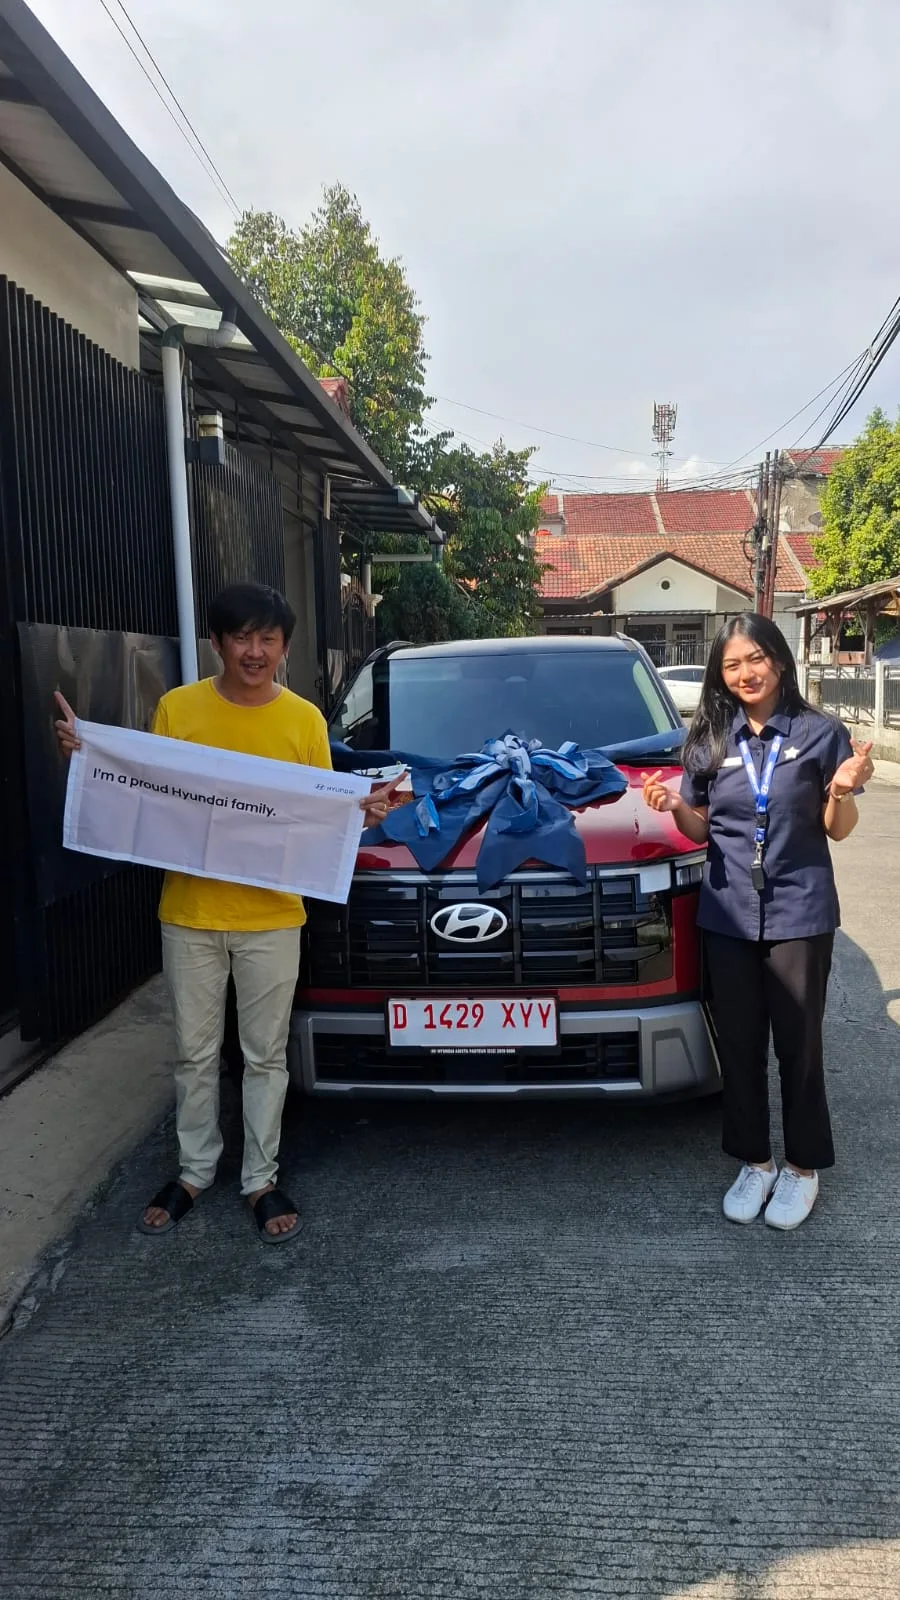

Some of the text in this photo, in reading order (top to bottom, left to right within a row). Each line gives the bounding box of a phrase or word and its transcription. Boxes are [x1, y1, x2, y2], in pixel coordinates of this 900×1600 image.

[92, 768, 276, 817] I'm a proud Hyundai family.
[393, 1003, 551, 1029] D 1429 XYY
